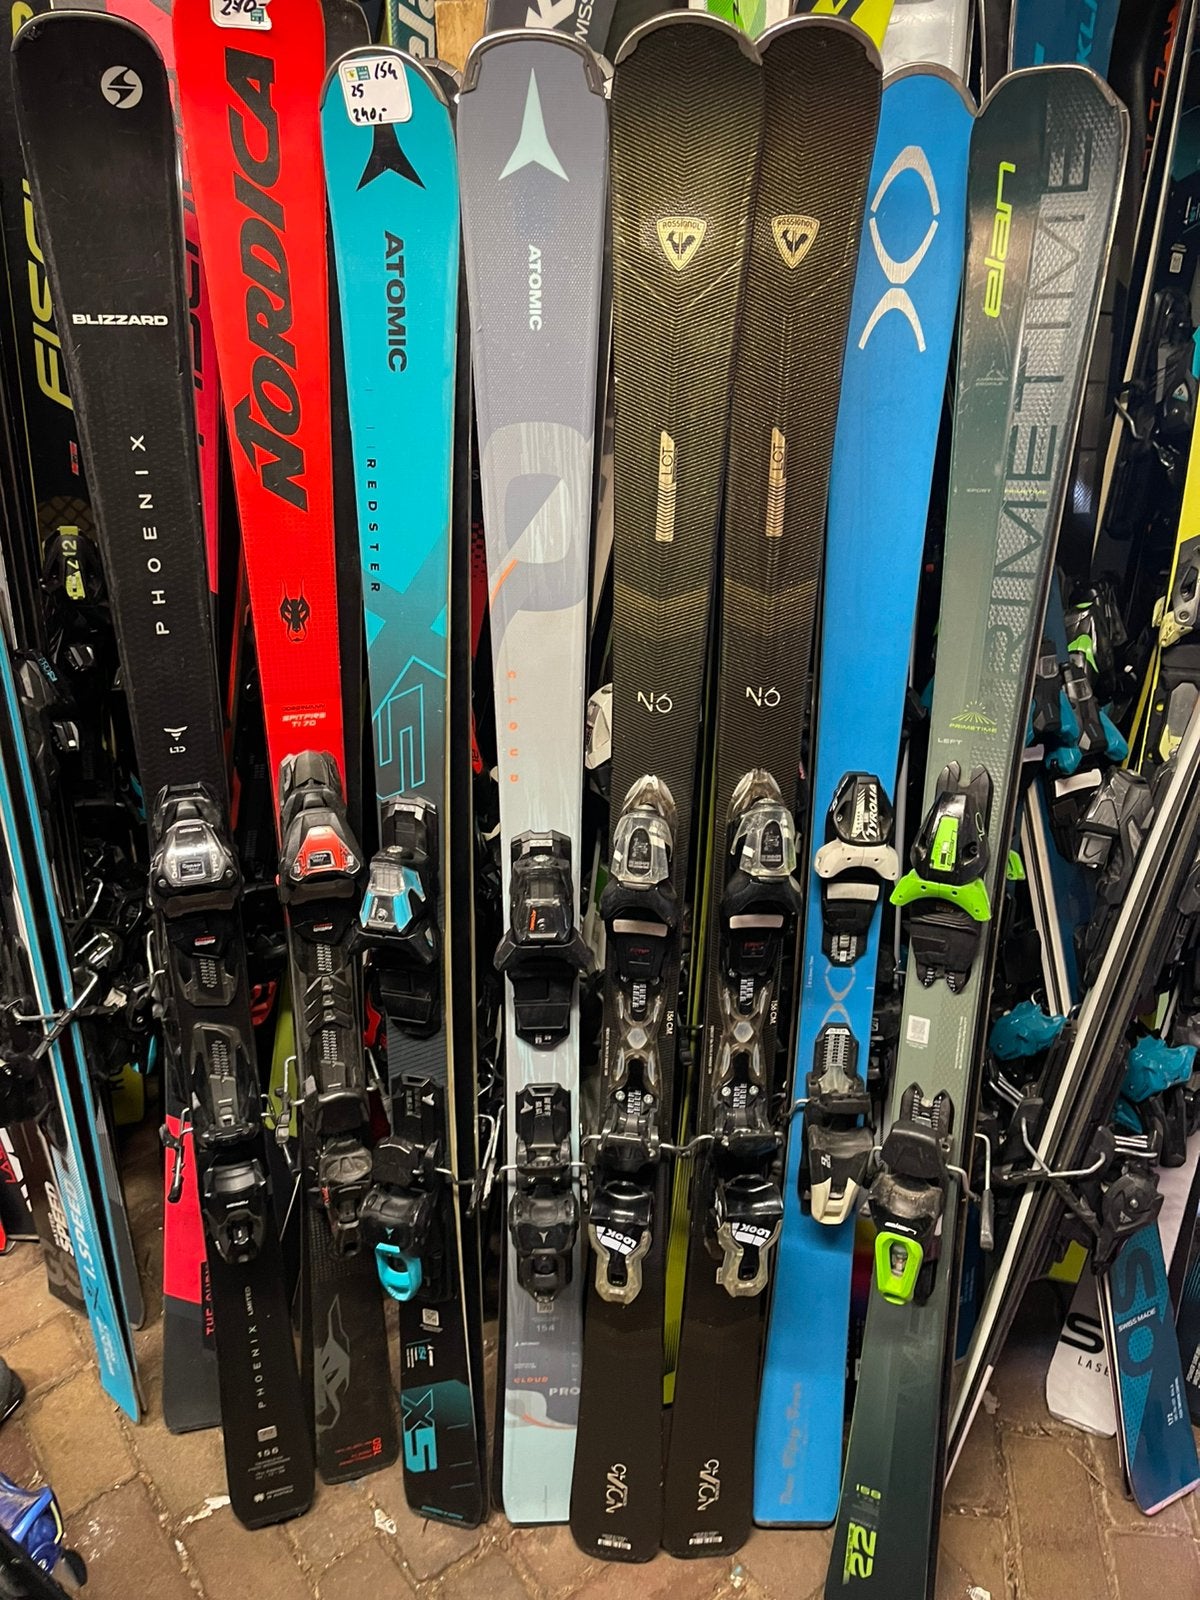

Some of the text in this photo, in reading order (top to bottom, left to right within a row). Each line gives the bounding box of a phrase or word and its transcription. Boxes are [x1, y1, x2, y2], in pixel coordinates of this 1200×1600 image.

[351, 84, 364, 98] 25
[662, 220, 702, 231] ROSSIGNOL
[776, 218, 814, 230] ROSSIGNOL
[982, 160, 1017, 318] elan
[224, 46, 310, 512] NORDICA
[527, 243, 543, 332] ATOMIC
[383, 230, 408, 374] ATOMIC
[72, 314, 169, 327] BLIZZARD
[661, 446, 674, 476] LCT
[771, 442, 785, 471] LCT
[129, 434, 172, 637] PHOENIX
[365, 457, 382, 593] REDSTER
[282, 711, 326, 722] SPITFIRE
[507, 669, 519, 784] CLOUD
[948, 722, 999, 735] PRIMETIME
[937, 737, 963, 745] LEFT
[866, 783, 879, 839] TYROLIA
[664, 1021, 674, 1036] CM
[768, 1011, 778, 1025] CM
[44, 1180, 75, 1257] SPEED
[739, 1223, 772, 1239] LOOK
[604, 1227, 638, 1248] LOOK
[1117, 1308, 1158, 1333] SWISS MADE
[244, 1285, 267, 1409] PHOENIX LIMITED
[513, 1375, 549, 1384] CLOUD
[548, 1386, 581, 1397] PRO
[849, 1524, 877, 1579] 22
